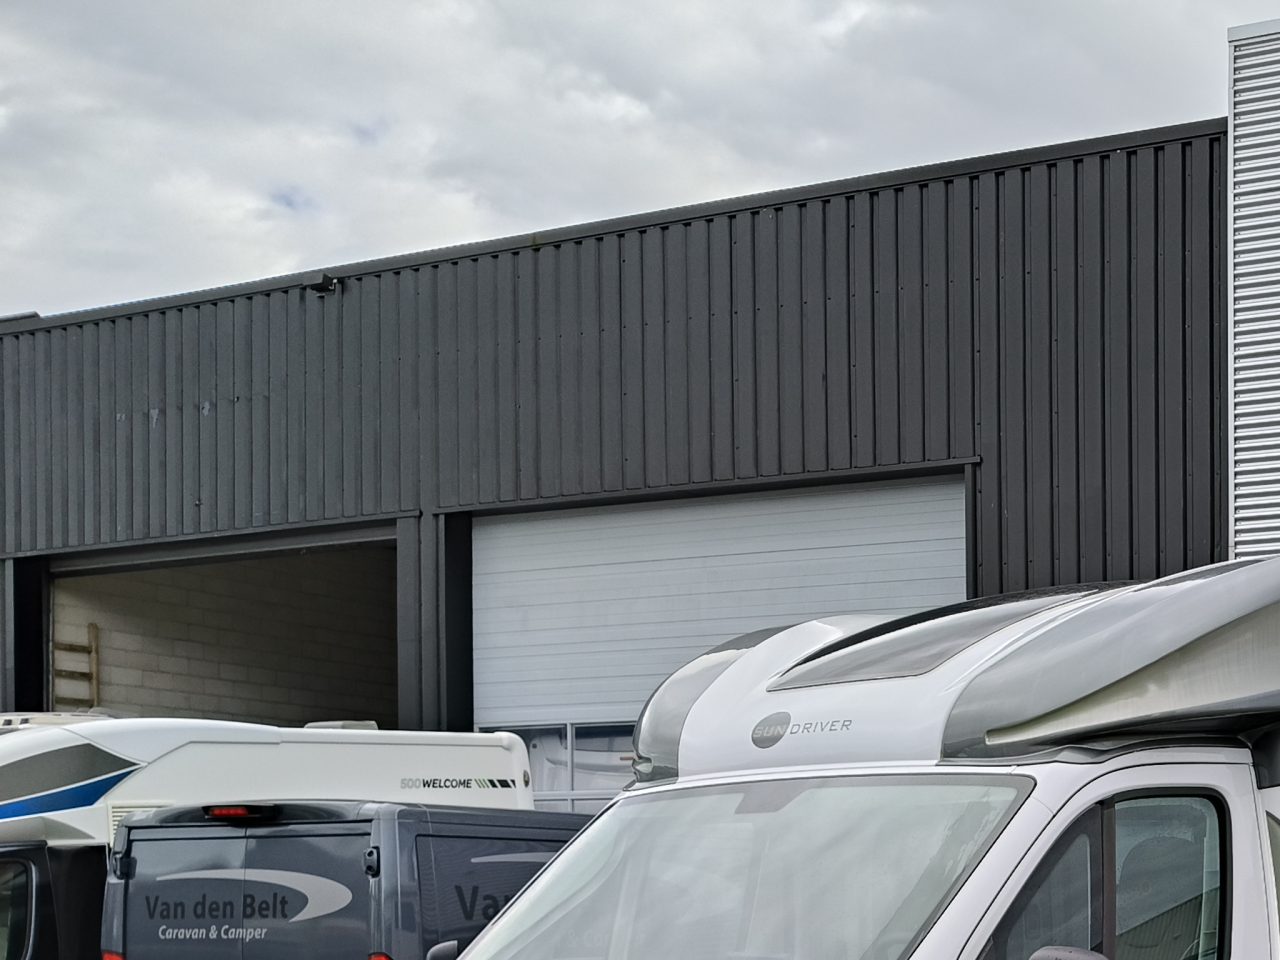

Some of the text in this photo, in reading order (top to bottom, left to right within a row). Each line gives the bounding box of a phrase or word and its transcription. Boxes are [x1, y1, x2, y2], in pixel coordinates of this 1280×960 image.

[752, 719, 853, 737] SUN DRIVER
[422, 778, 473, 789] WELCOME
[145, 892, 289, 920] Van den Belt
[158, 924, 268, 942] Caravan & Camper
